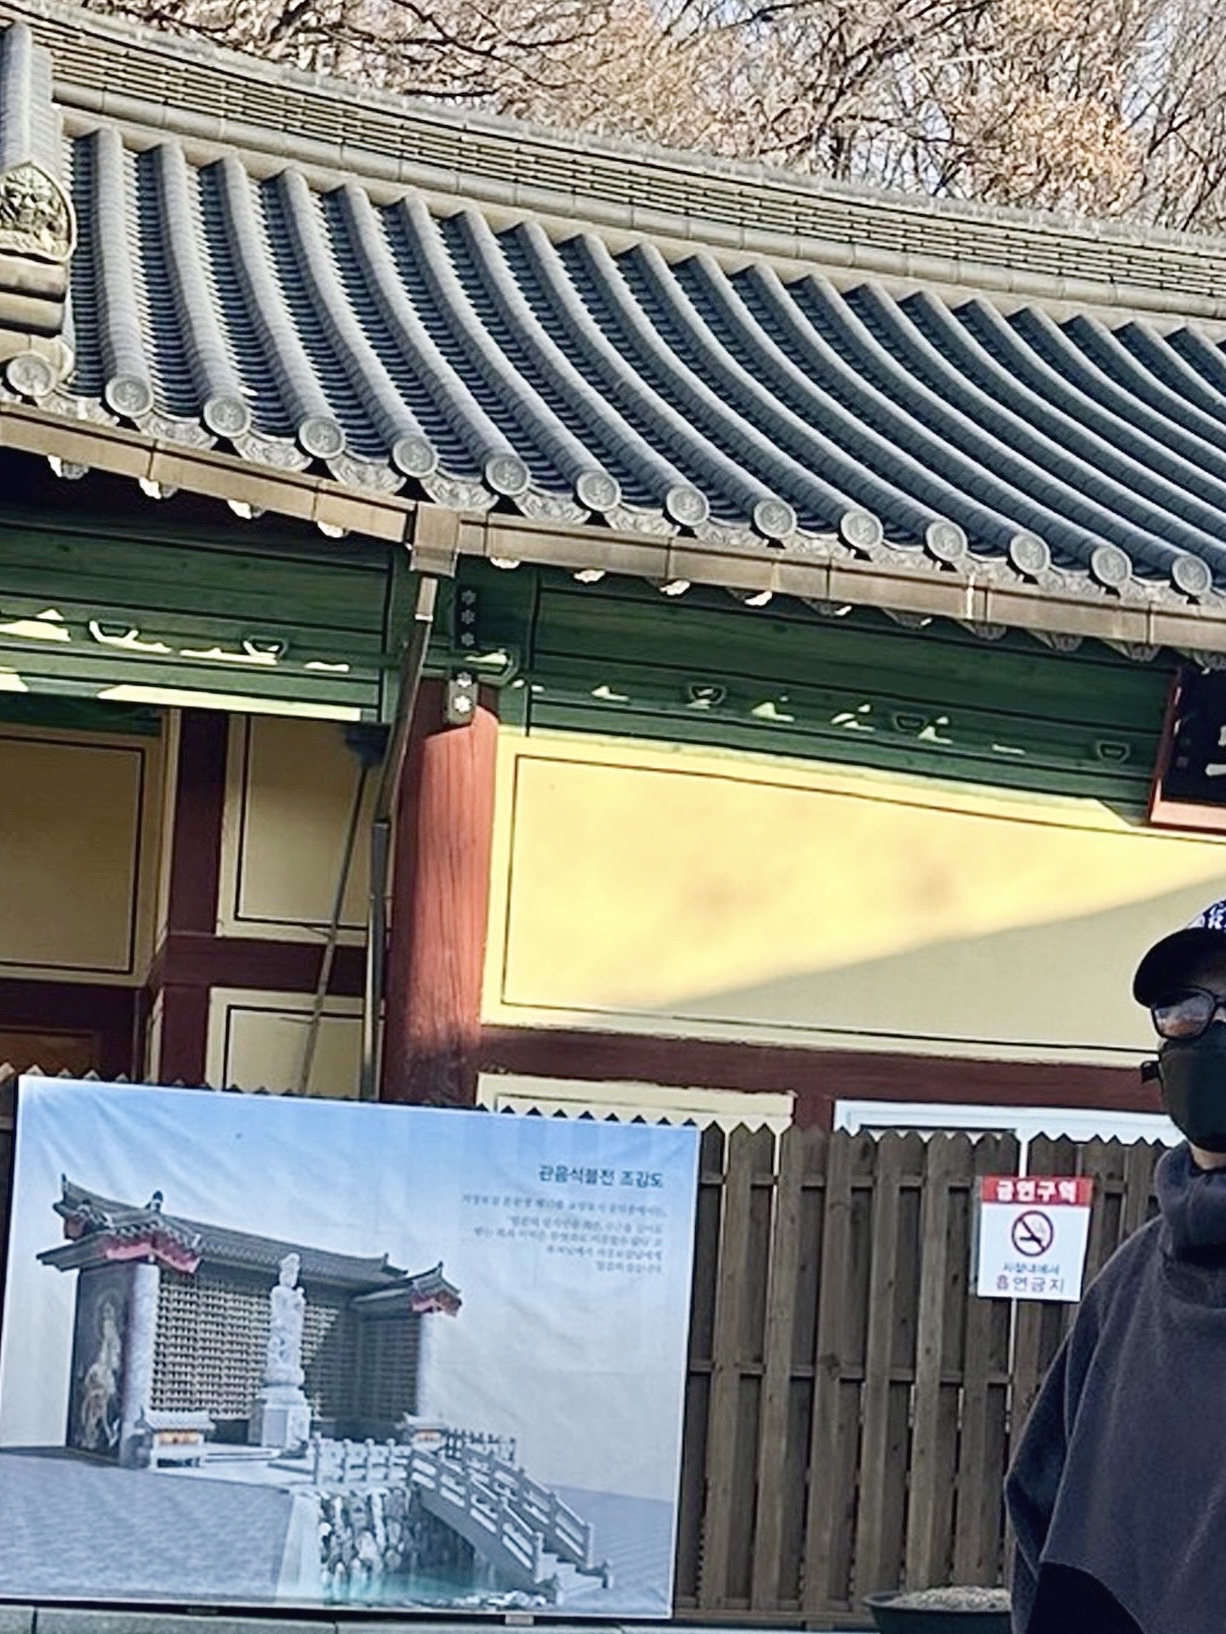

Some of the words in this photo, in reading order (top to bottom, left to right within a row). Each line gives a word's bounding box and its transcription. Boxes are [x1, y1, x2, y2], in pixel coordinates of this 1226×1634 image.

[620, 1171, 664, 1188] 조감도
[997, 1180, 1077, 1203] 금연구역
[996, 1275, 1064, 1292] 흡연금지
